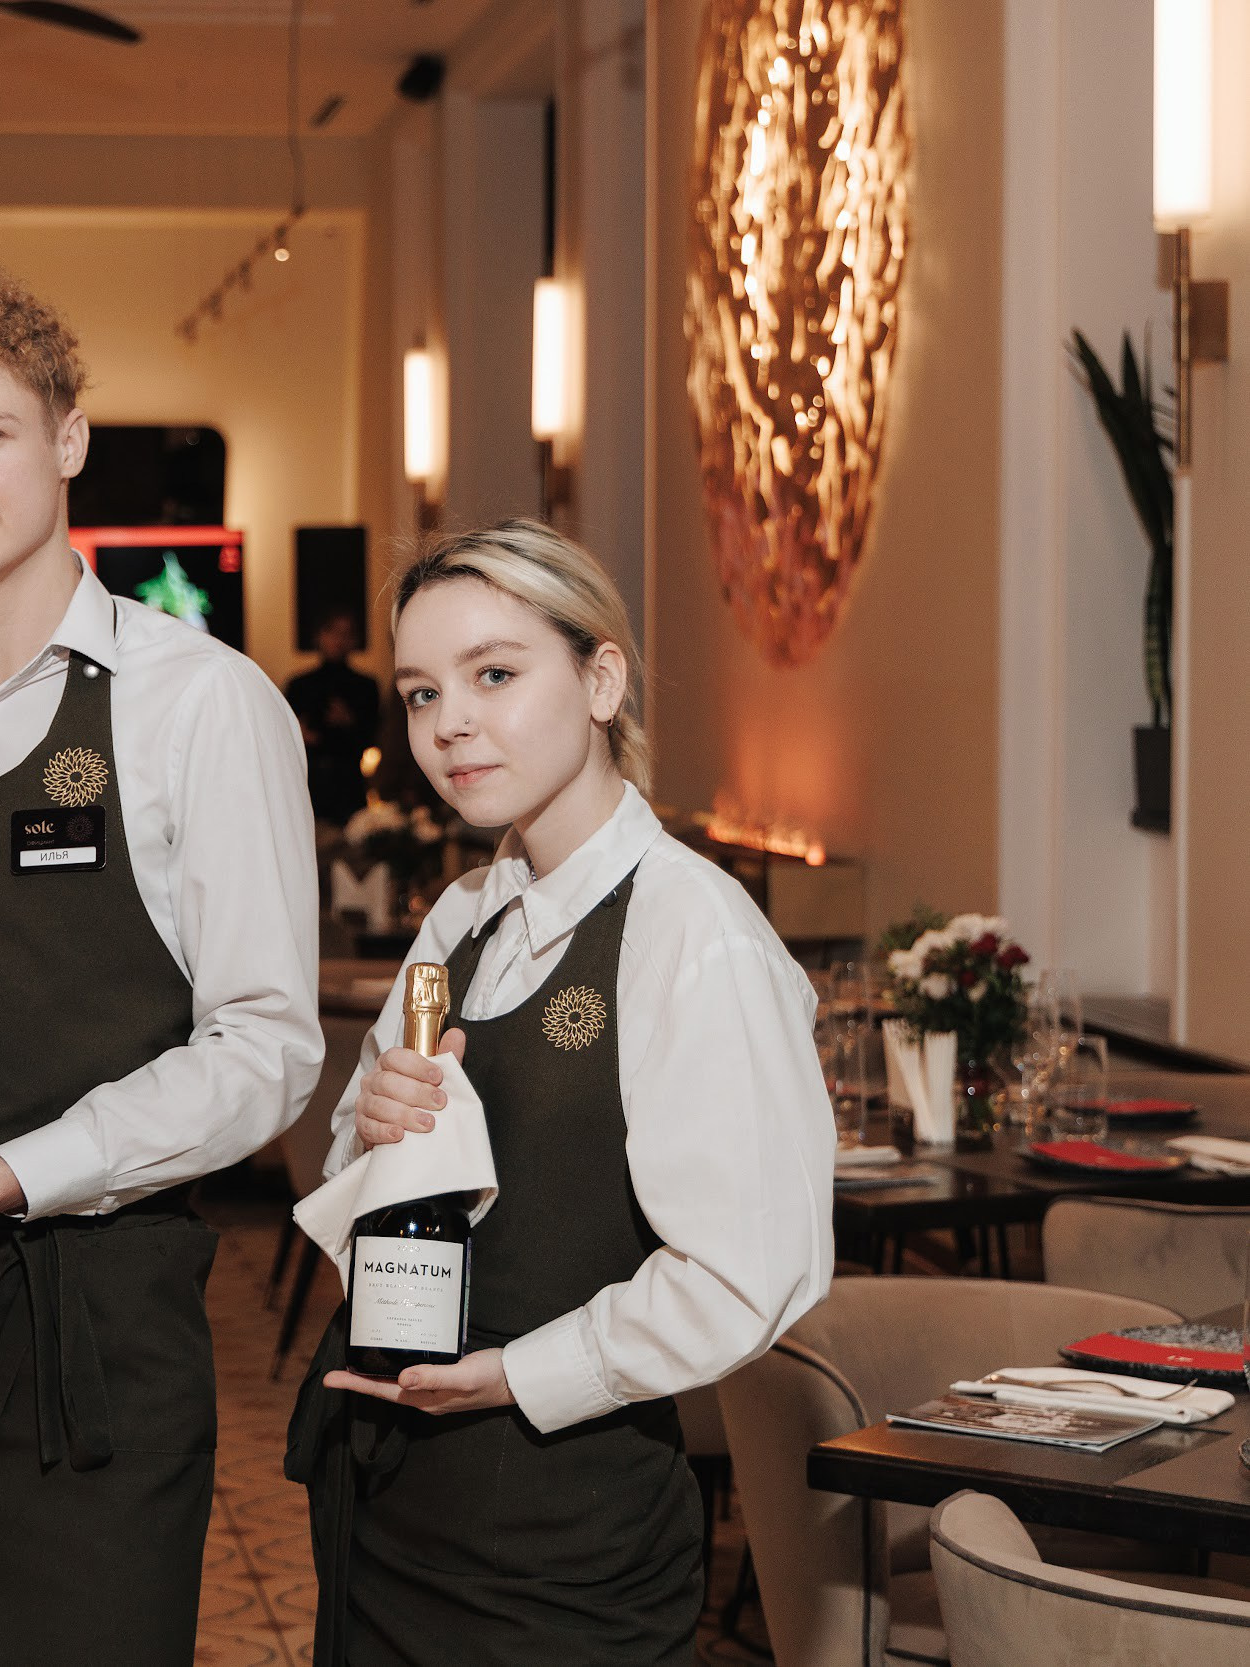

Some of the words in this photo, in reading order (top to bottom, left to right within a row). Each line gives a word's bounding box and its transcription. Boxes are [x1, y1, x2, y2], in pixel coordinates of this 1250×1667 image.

[24, 820, 56, 835] sole
[40, 850, 69, 862] ИЛЬЯ
[364, 1261, 452, 1279] MAGNATUM
